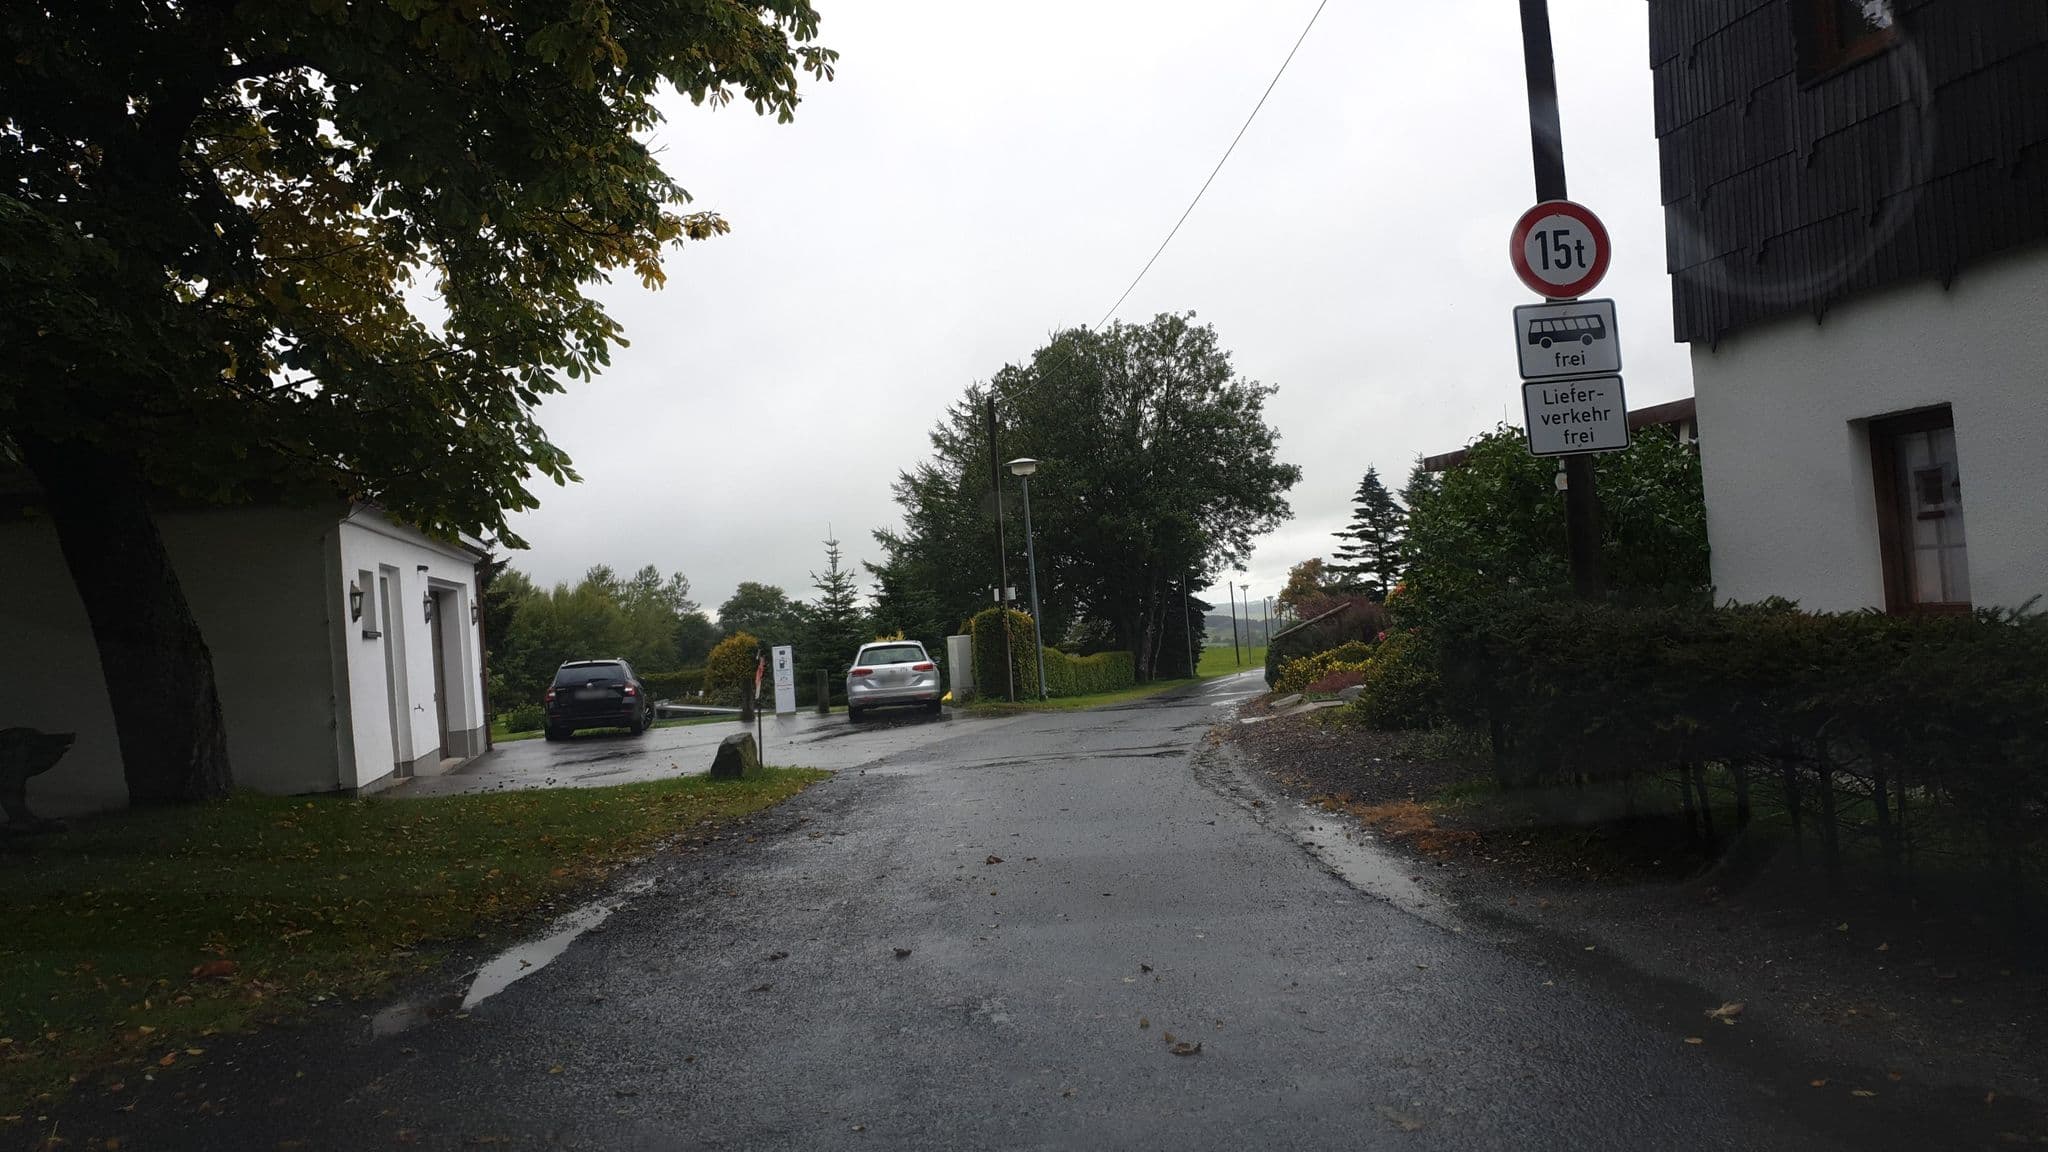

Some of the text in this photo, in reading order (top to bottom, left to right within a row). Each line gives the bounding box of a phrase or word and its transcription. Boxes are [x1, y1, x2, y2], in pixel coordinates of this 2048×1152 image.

[1555, 351, 1585, 368] frei
[1543, 388, 1604, 406] Liefer-
[1541, 407, 1611, 426] verkehr
[1564, 428, 1594, 445] frei
